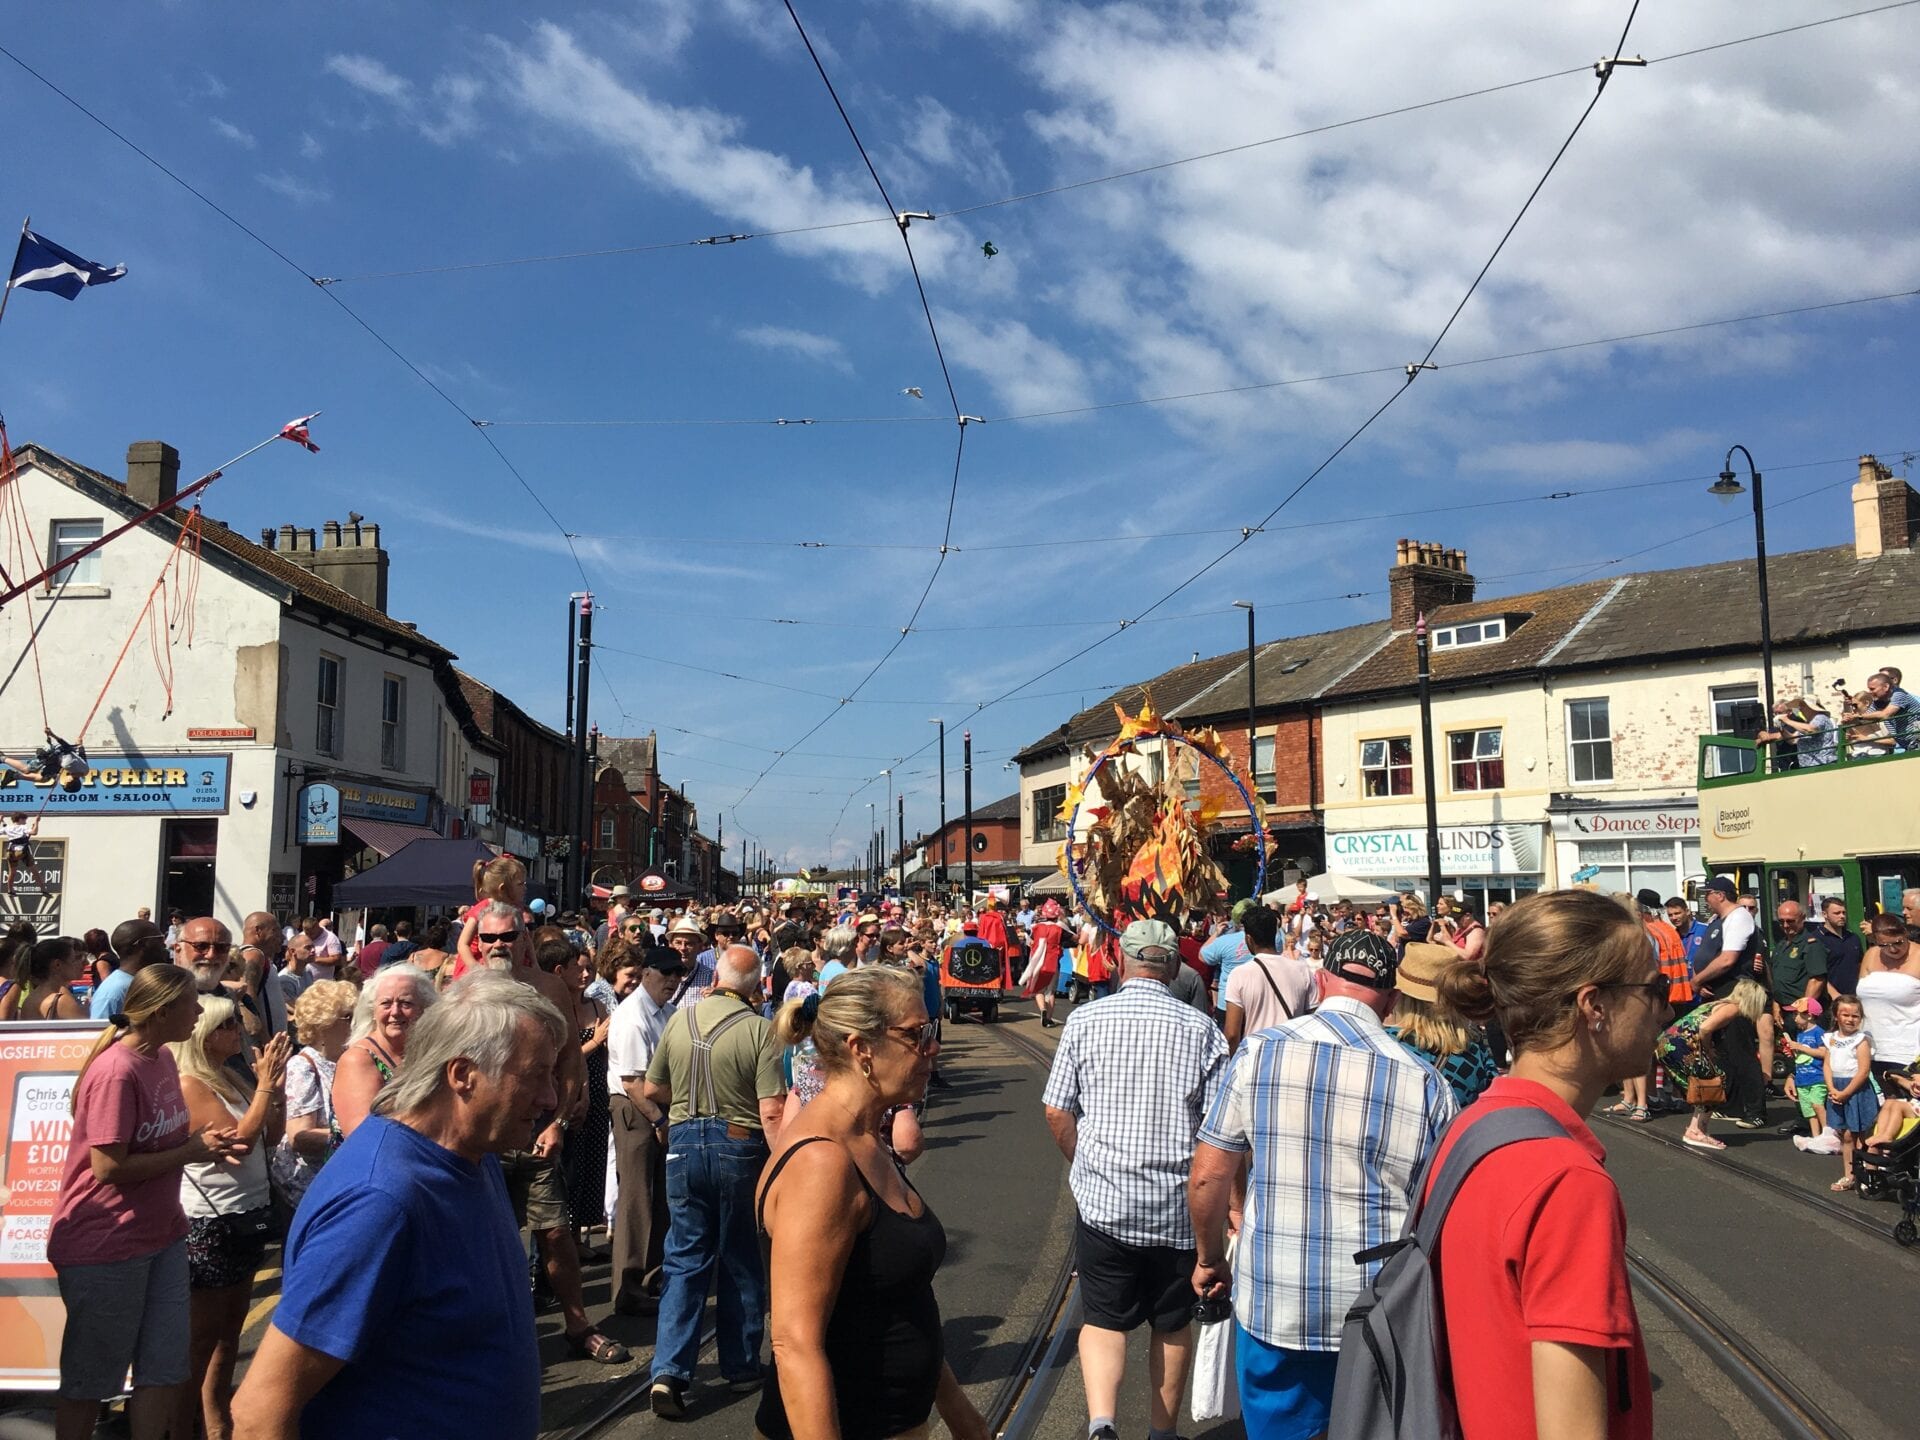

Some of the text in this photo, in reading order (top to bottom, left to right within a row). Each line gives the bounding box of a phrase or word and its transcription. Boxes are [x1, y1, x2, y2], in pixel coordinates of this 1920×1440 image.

[226, 729, 251, 737] STREET
[49, 793, 99, 802] GROOM
[113, 793, 172, 802] SALOON
[367, 791, 417, 810] BUTCHER
[1719, 808, 1750, 821] Blackpool
[1590, 814, 1650, 832] Dance
[1720, 820, 1751, 833] Transport
[1333, 829, 1505, 854] CRYSTAL LINDS
[1342, 853, 1495, 865] VERTICAL VENETN ROLLER
[45, 870, 61, 884] PIN
[1336, 949, 1388, 977] RAIDERS
[0, 1045, 57, 1060] GSELFIE
[26, 1088, 58, 1100] Chris
[30, 1119, 74, 1142] WIN
[28, 1167, 58, 1175] WORTH
[8, 1198, 54, 1208] VOUCHERS
[17, 1216, 51, 1226] FOR THE
[13, 1242, 23, 1251] AT
[24, 1242, 41, 1251] THIS
[10, 1252, 33, 1261] TRAM
